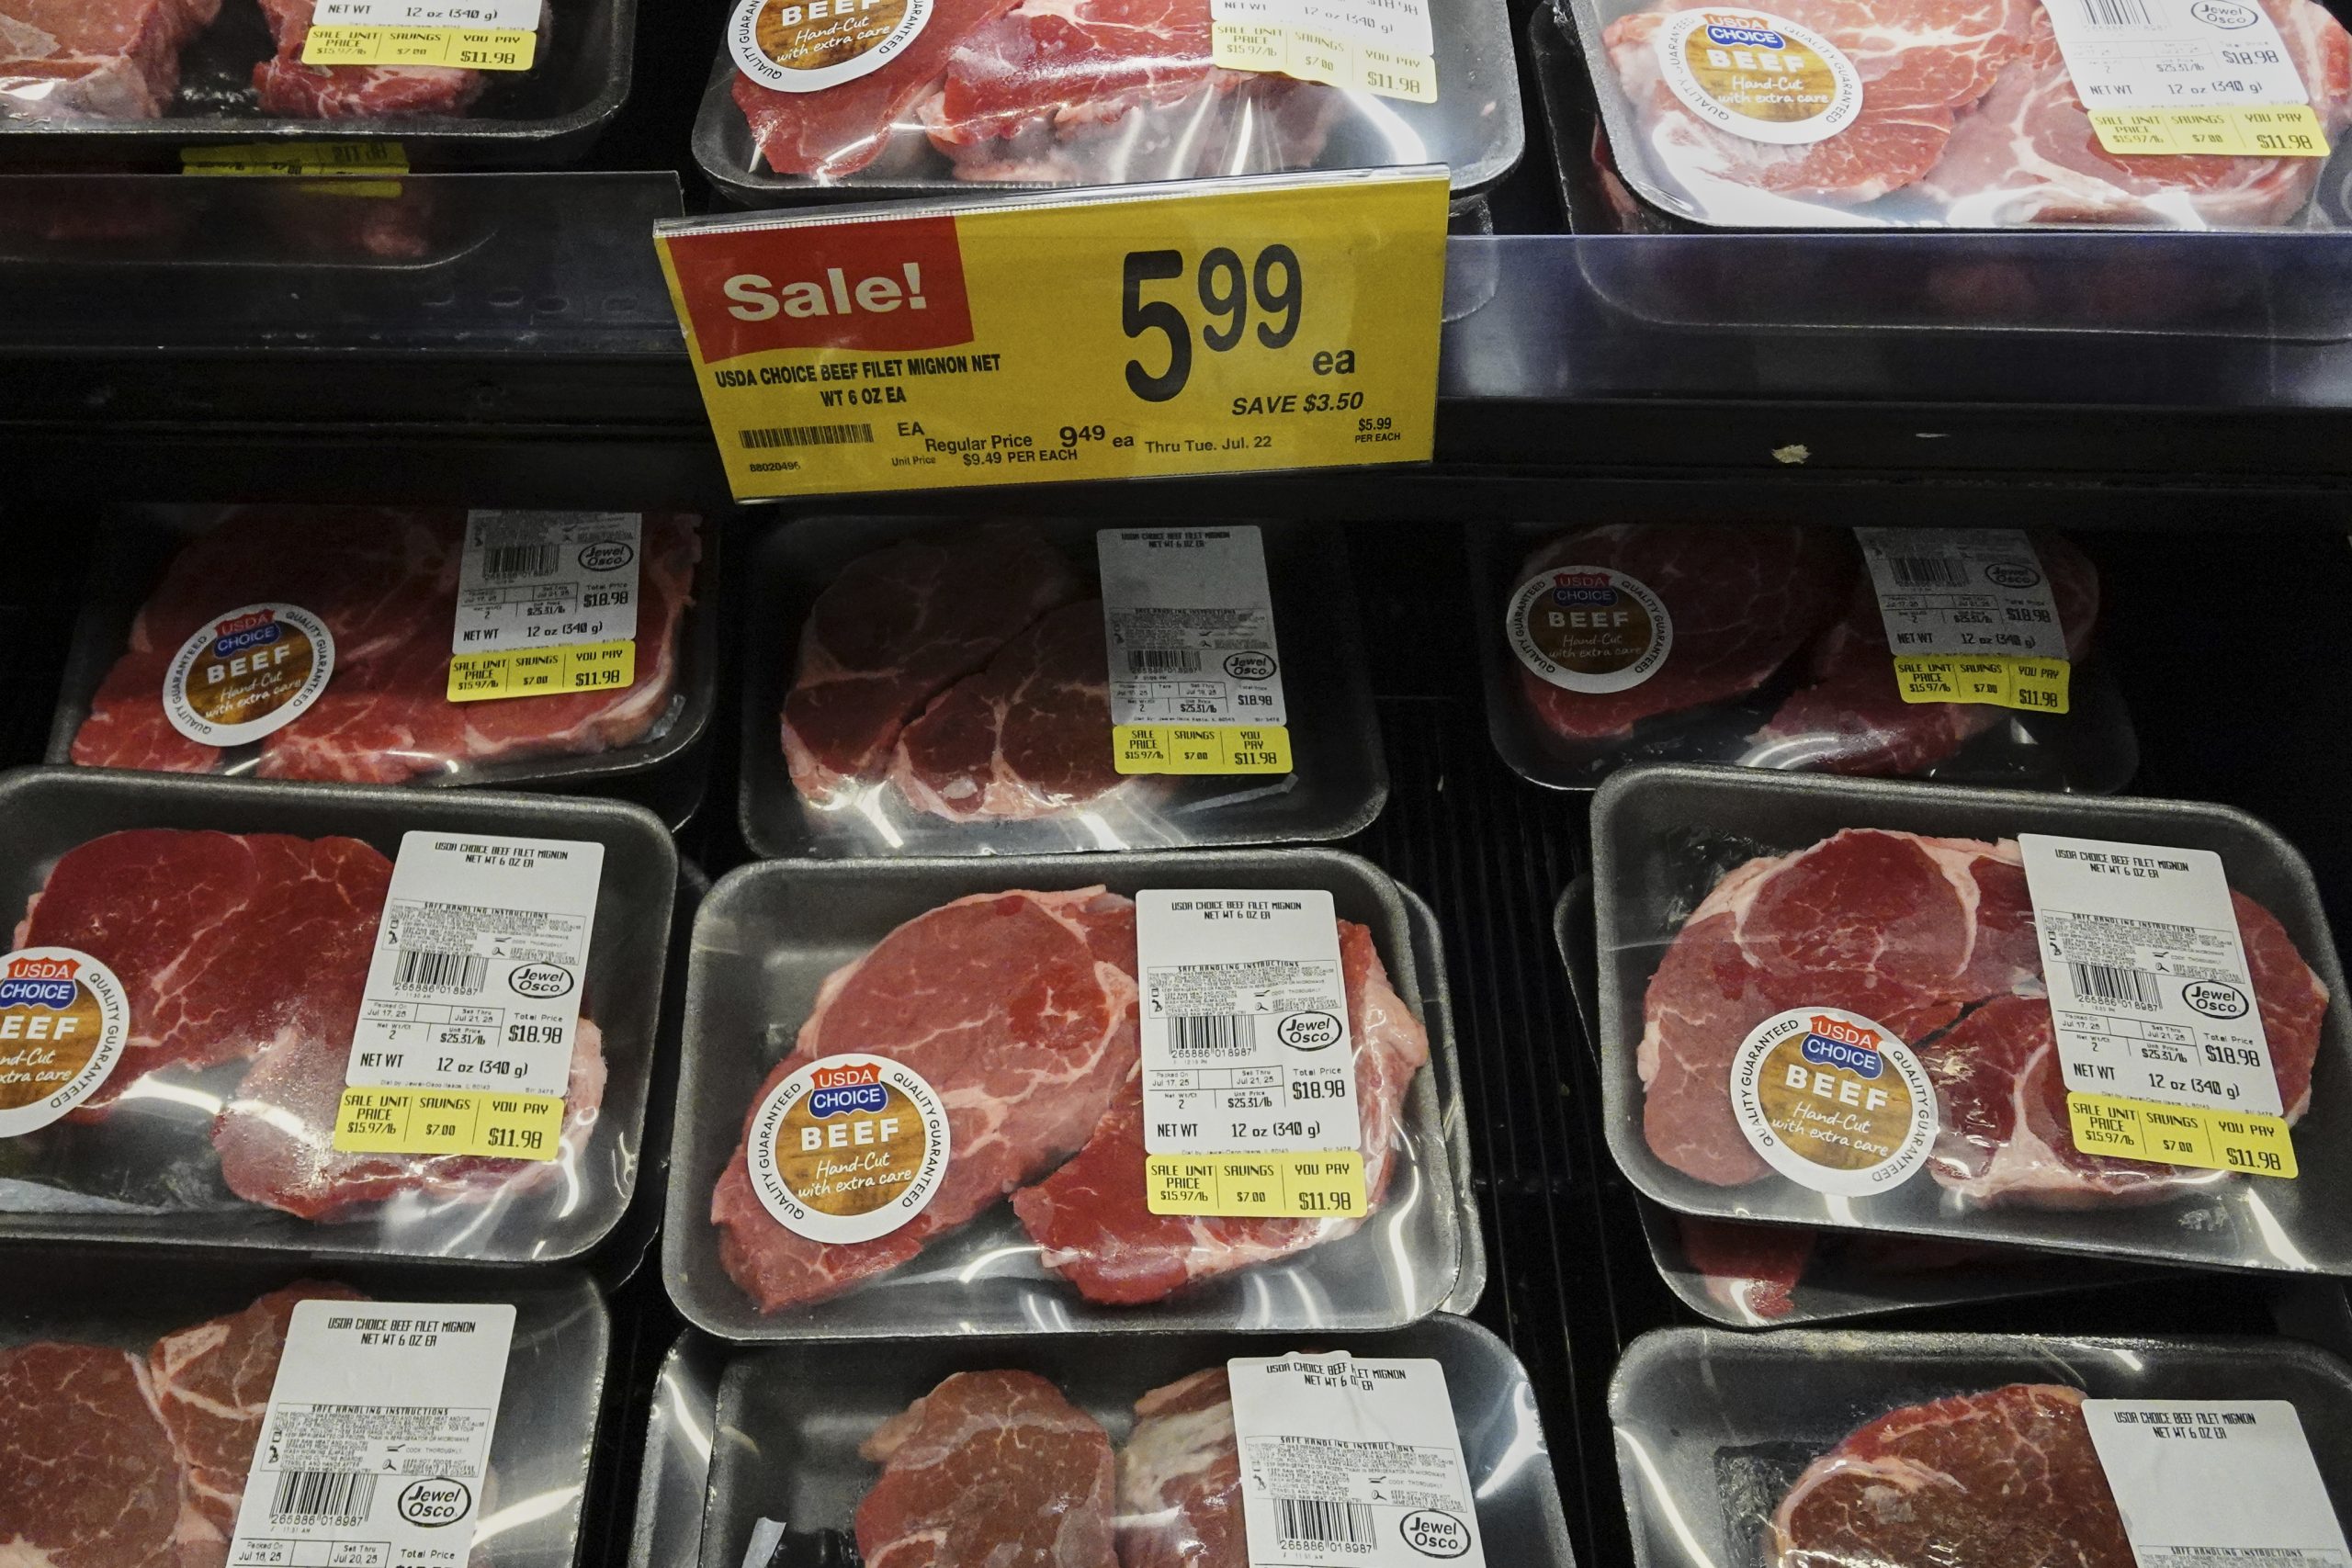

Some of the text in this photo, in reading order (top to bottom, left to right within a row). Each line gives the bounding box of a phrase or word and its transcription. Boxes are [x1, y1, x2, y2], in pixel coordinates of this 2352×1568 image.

[795, 16, 869, 45] Hand-Cut
[1710, 16, 1764, 29] USDA
[1711, 28, 1777, 43] CHOICE
[460, 51, 515, 64] $11.98
[1706, 49, 1805, 73] BEEF
[2256, 135, 2312, 150] $11.98
[723, 262, 926, 321] Sale!
[1312, 348, 1355, 376] ea
[715, 354, 1001, 388] USDA CHOICE BEEF FILET MIGNON NET
[820, 387, 906, 406] WT 6 OZ EA
[1231, 392, 1363, 416] SAVE $3.50
[898, 422, 924, 436] EA
[1358, 418, 1392, 432] $5.99
[925, 434, 1033, 456] Regular Price
[1113, 434, 1134, 448] ea
[1145, 435, 1272, 454] Thru Tue. Jul. 22
[1354, 433, 1400, 443] PER EACH
[892, 449, 1078, 467] Unit Price $9.49 PER EACH
[750, 461, 800, 472] 88020496
[207, 644, 290, 684] BEEF
[575, 670, 620, 687] $11.98
[2018, 688, 2058, 707] $11.98
[1234, 752, 1277, 765] $11.98
[1171, 902, 1193, 910] USDA
[1227, 901, 1243, 909] BEEF
[1272, 902, 1301, 910] MIGNON
[1204, 911, 1219, 919] NET
[14, 964, 69, 978] USDA
[517, 968, 565, 982] Jewel
[1, 985, 71, 999] CHOICE
[518, 980, 560, 992] Osco
[2191, 987, 2235, 1000] Jewel
[2196, 998, 2237, 1012] Osco
[1286, 1018, 1330, 1032] Jewel
[508, 1024, 562, 1044] $18.98
[1289, 1031, 1329, 1043] Osco
[1817, 1021, 1872, 1048] USDA
[1807, 1038, 1876, 1070] CHOICE
[2205, 1044, 2261, 1067] $18.98
[436, 1057, 528, 1078] 12 oz (340 g)
[819, 1070, 874, 1088] USDA
[2074, 1064, 2240, 1100] NET WT 12 oz (340 g)
[1293, 1079, 1345, 1100] $18.98
[1786, 1065, 1889, 1111] BEEF
[420, 1098, 470, 1110] SAVINGS
[492, 1101, 548, 1113] YOU PAY
[814, 1089, 880, 1109] CHOICE
[1179, 1100, 1184, 1109] 2
[1793, 1101, 1871, 1134] Hand-Cut
[2074, 1103, 2136, 1120] SALE UNIT
[2090, 1117, 2124, 1132] PRICE
[2146, 1112, 2199, 1128] SAVINGS
[426, 1124, 456, 1136] $7.00
[801, 1118, 899, 1151] BEEF
[1157, 1120, 1320, 1138] NET WT 12 oz (340 g)
[1772, 1118, 1888, 1156] with extra care
[2219, 1122, 2274, 1136] YOU PAY
[488, 1128, 543, 1149] $11.98
[893, 1073, 941, 1207] QUALITY GUARANTEED
[2163, 1140, 2193, 1153] $7.00
[759, 1083, 805, 1220] QUALITY GUARANTEED
[2226, 1148, 2280, 1170] $11.98
[816, 1152, 890, 1179] Hand-Cut
[1151, 1165, 1214, 1176] SALE UNIT
[1224, 1166, 1274, 1176] SAVINGS
[1295, 1164, 1350, 1175] YOU PAY
[797, 1169, 911, 1198] with extra care
[1166, 1178, 1200, 1189] PRICE
[1237, 1192, 1265, 1202] $7.00
[1299, 1192, 1351, 1211] $11.98
[328, 1318, 475, 1333] USDA CHOICE BEEF FILET MIGNON
[360, 1334, 379, 1345] NET
[382, 1334, 396, 1345] WT
[398, 1335, 405, 1346] 6
[410, 1335, 422, 1346] OZ
[2142, 1412, 2256, 1425] CHOICE BEEF FILET MIGNON
[408, 1486, 460, 1502] Jewel
[409, 1503, 454, 1517] Osco
[1409, 1517, 1457, 1535] Jewel
[1415, 1532, 1459, 1550] Osco
